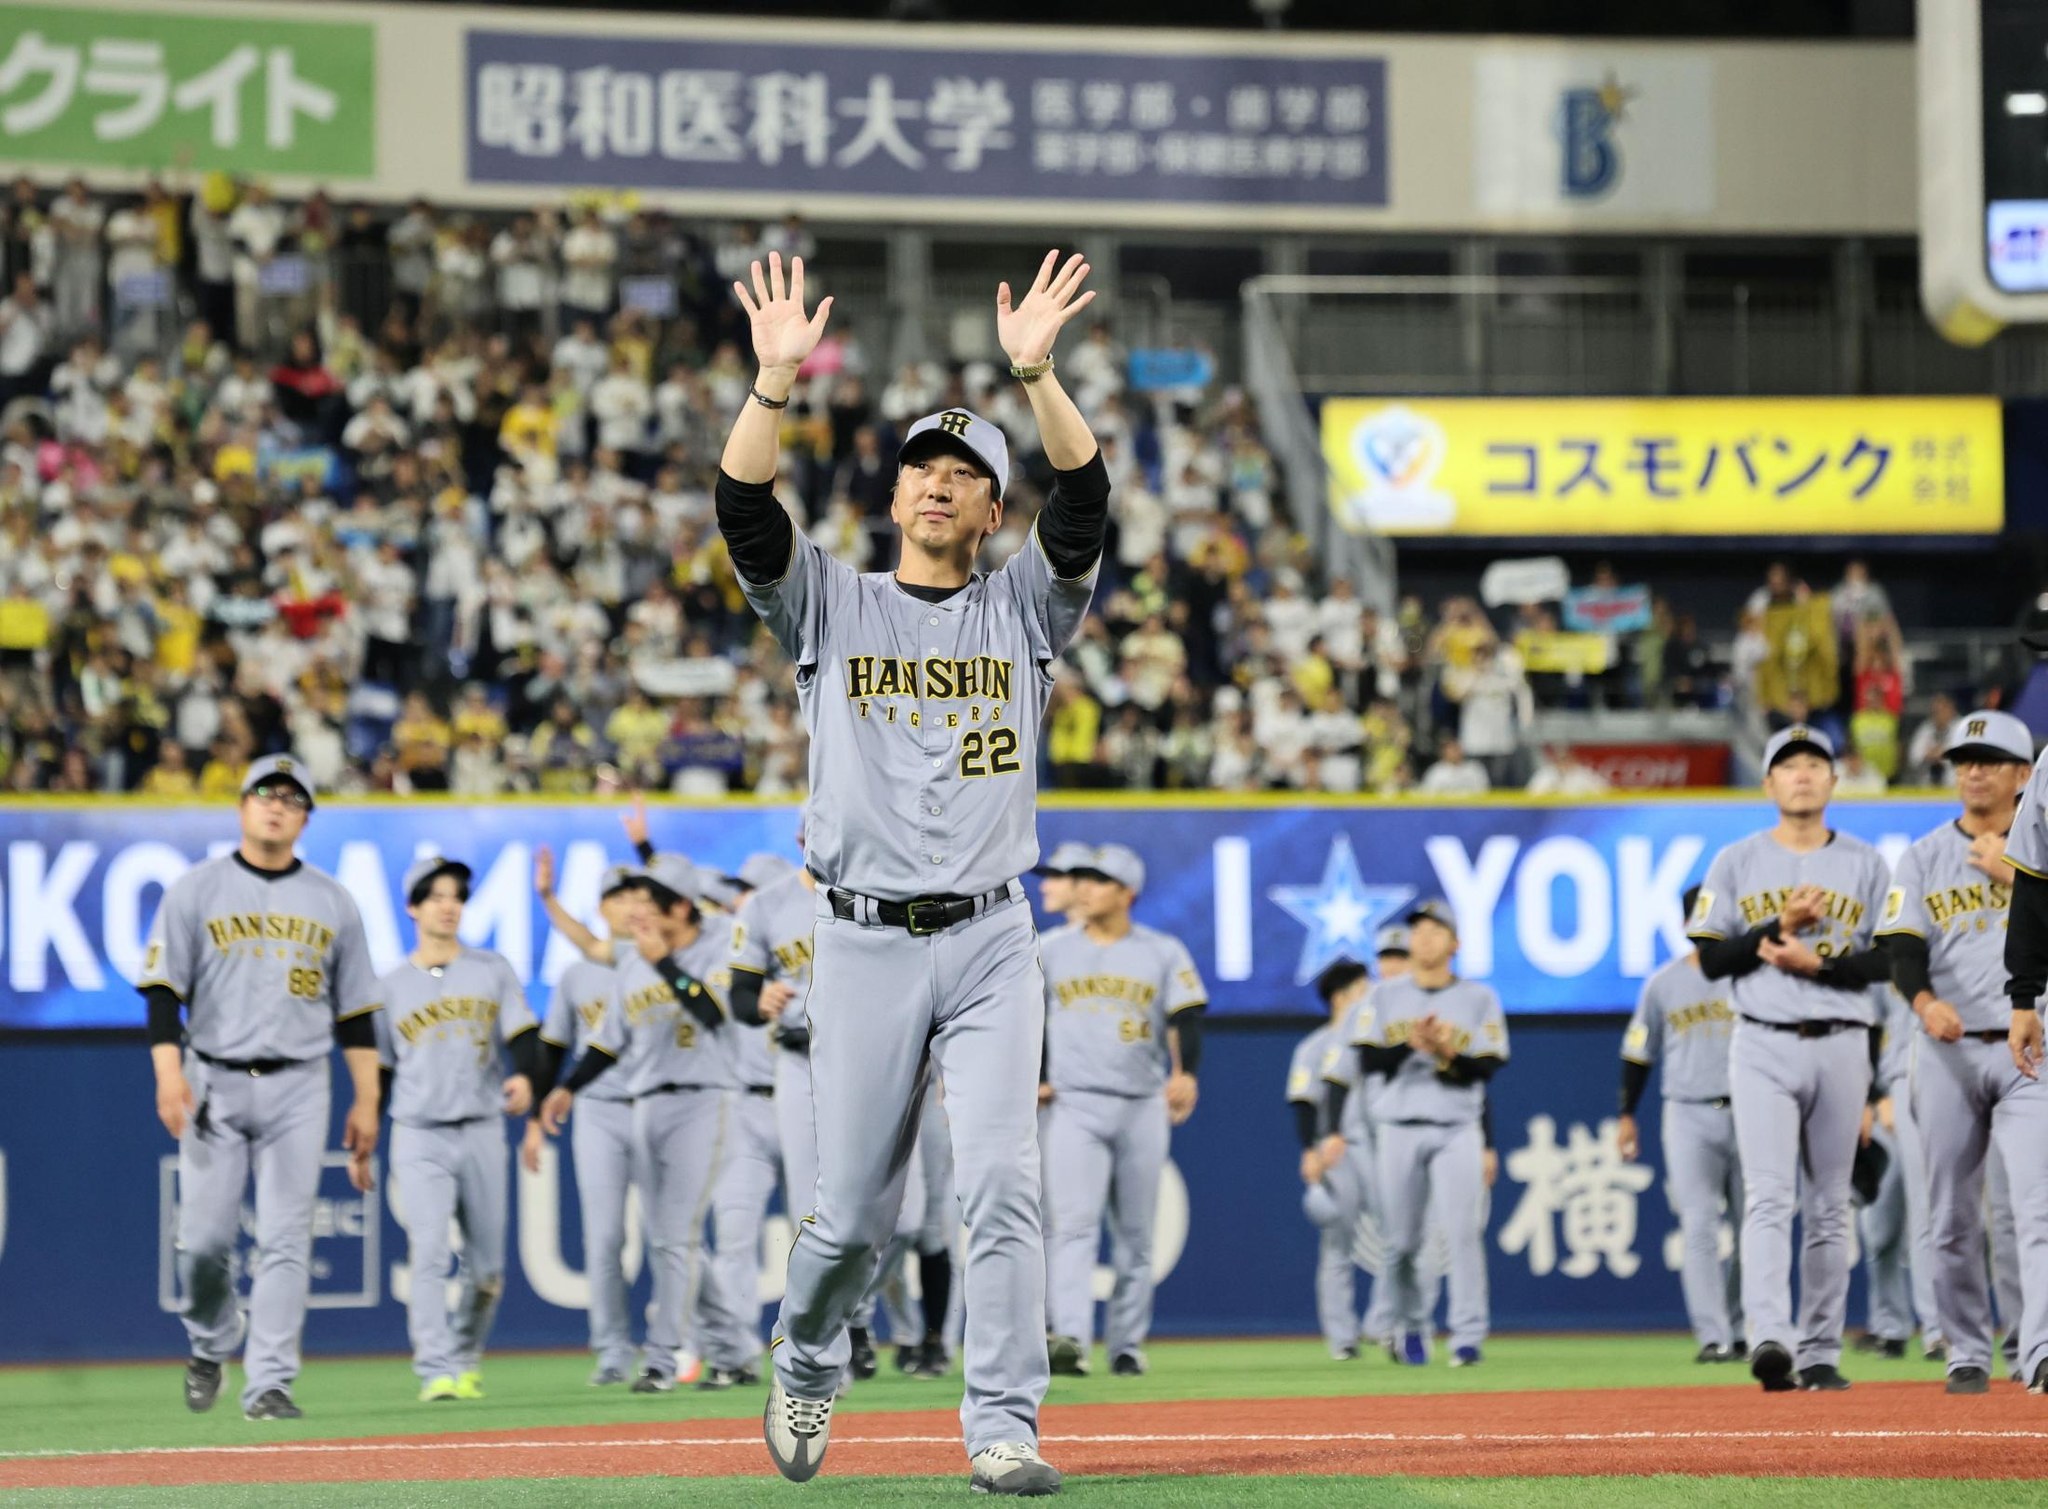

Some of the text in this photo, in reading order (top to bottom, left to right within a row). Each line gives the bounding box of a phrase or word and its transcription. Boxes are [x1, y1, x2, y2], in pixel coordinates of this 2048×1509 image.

[475, 62, 1015, 172] 昭和医科大学
[1484, 436, 1894, 500] コスモバンク
[847, 655, 1013, 702] HANSHIN
[859, 701, 1002, 729] TIGERS
[958, 727, 1023, 779] 22
[206, 911, 337, 954] HANSHIN
